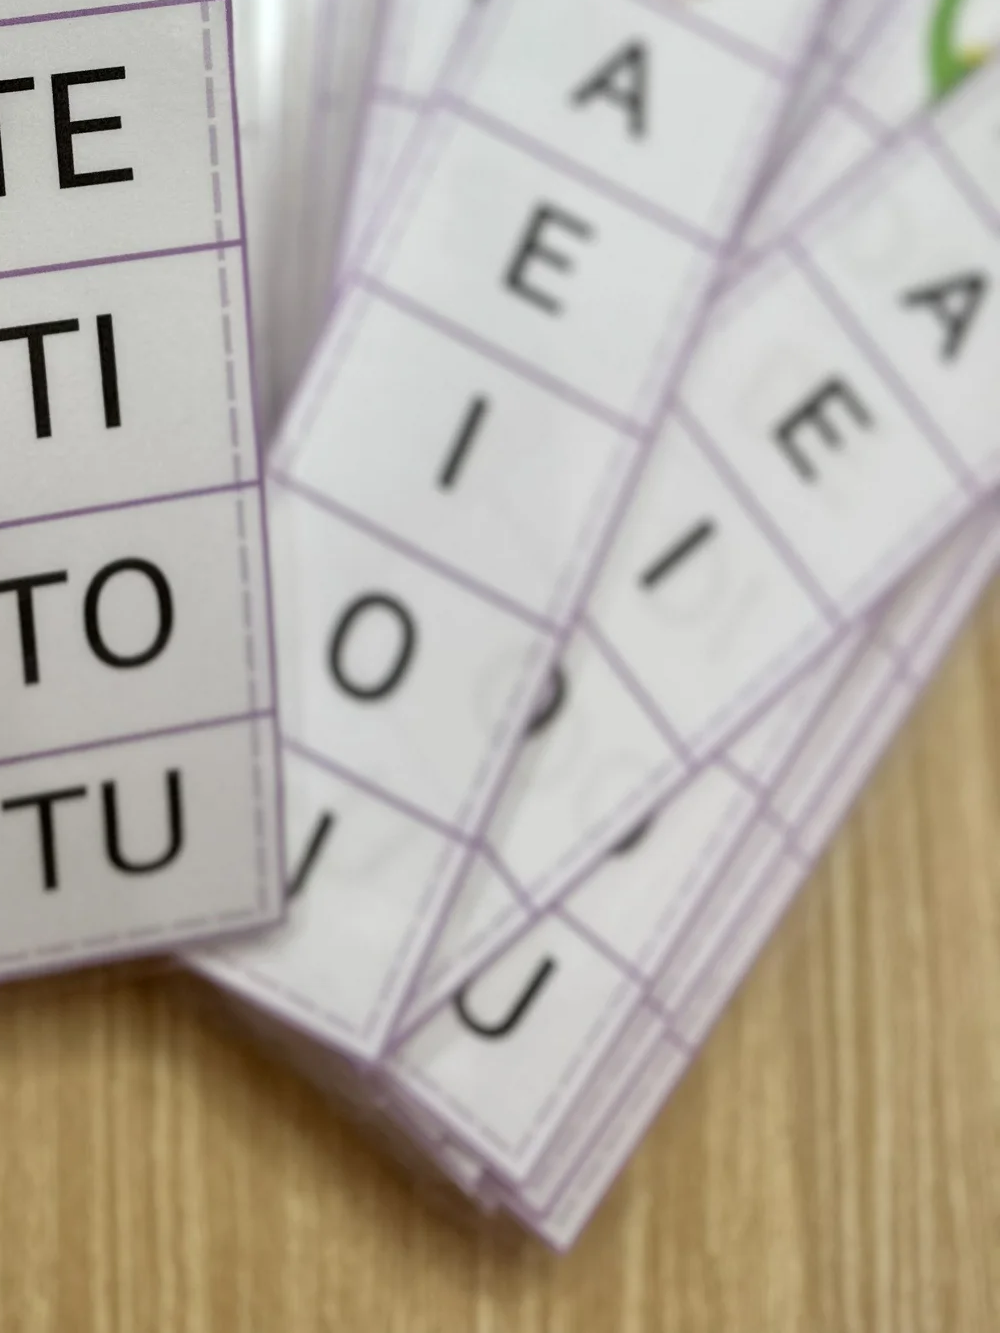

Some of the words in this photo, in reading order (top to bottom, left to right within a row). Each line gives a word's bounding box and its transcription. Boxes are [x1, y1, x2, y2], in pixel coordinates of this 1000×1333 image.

[568, 38, 650, 139] A
[500, 199, 594, 317] E
[900, 270, 990, 363] A
[437, 395, 489, 492] I
[772, 375, 873, 484] E
[637, 518, 716, 592] I
[325, 590, 419, 705] O
[0, 768, 184, 892] TU
